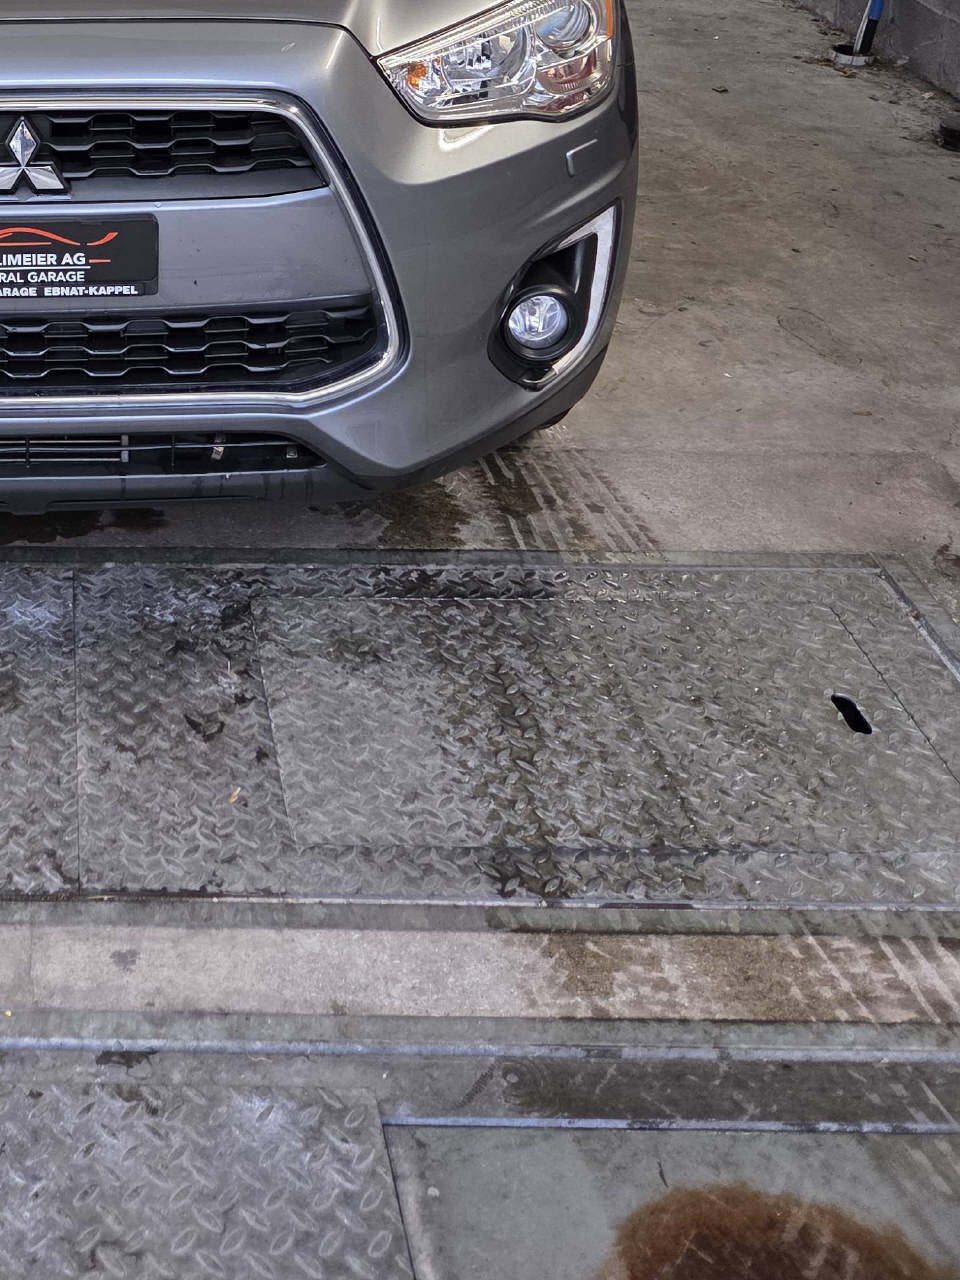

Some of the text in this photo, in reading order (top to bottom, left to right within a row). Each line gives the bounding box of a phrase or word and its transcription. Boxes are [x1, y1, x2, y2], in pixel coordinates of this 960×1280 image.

[61, 253, 86, 266] AG
[27, 271, 86, 283] GARAGE
[43, 285, 139, 297] EBNAT-KAPPEL
